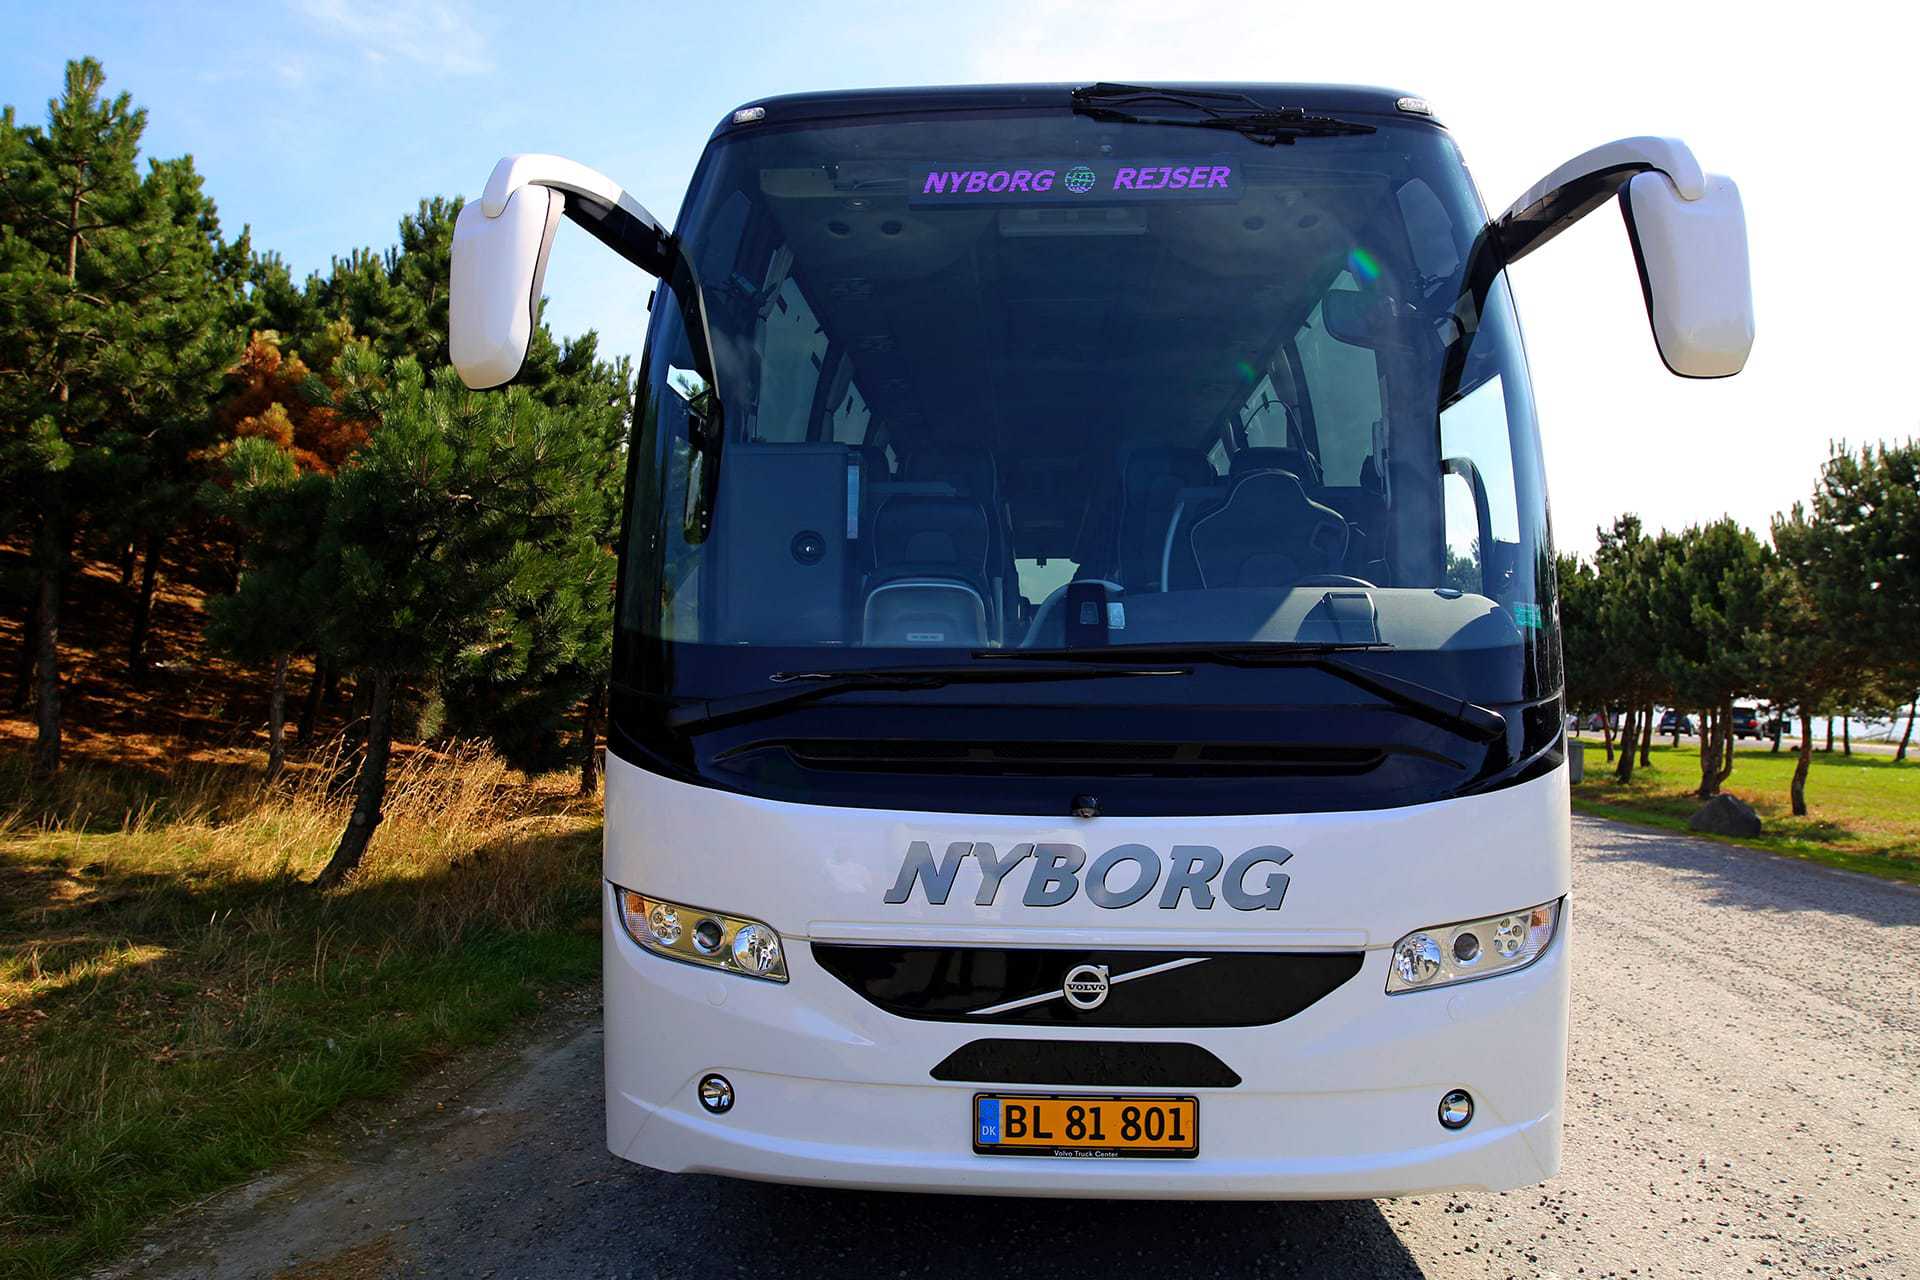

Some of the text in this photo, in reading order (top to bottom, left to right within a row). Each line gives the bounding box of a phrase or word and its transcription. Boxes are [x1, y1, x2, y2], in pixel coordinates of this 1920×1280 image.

[922, 166, 1231, 193] NYBORG REJSER
[883, 840, 1294, 911] NYBORG
[1066, 983, 1106, 991] VOLVO
[982, 1125, 996, 1136] DK
[1005, 1104, 1185, 1142] BL 81 801
[1094, 1150, 1119, 1158] Center
